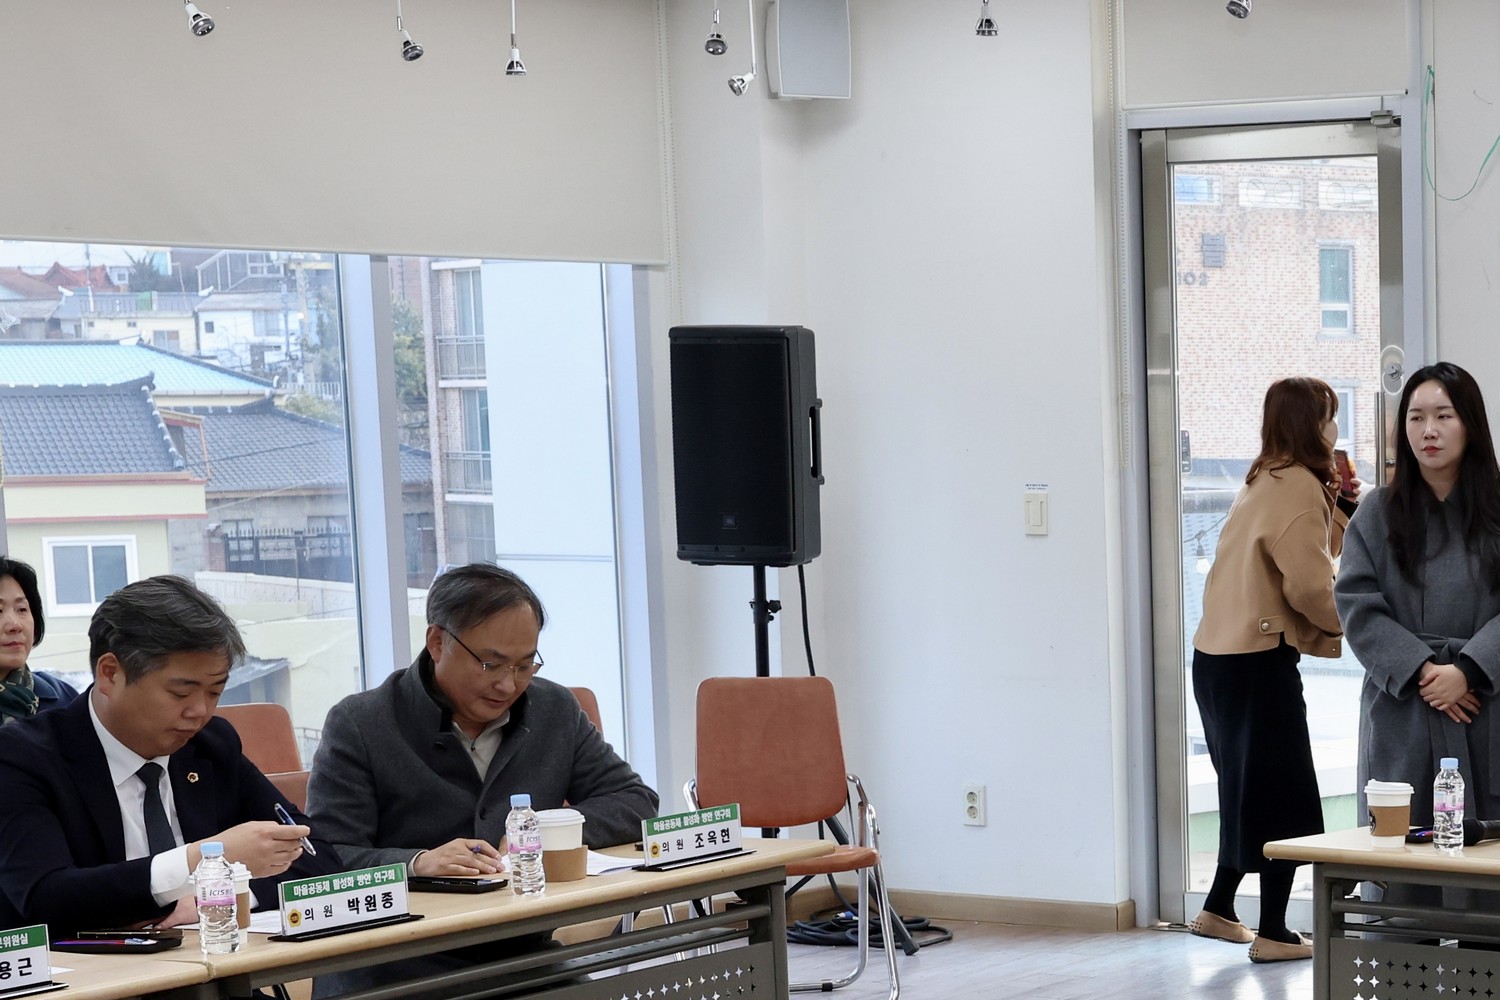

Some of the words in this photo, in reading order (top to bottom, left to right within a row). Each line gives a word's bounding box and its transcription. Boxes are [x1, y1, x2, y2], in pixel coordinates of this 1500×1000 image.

[653, 817, 682, 832] 마을공동체
[701, 811, 713, 823] 방안
[714, 808, 731, 820] 연구회
[694, 827, 730, 849] 조옥현
[293, 880, 330, 897] 마을공동체
[332, 877, 355, 891] 활성화
[357, 874, 371, 887] 방안
[373, 869, 395, 883] 연구회
[347, 891, 394, 914] 박원종
